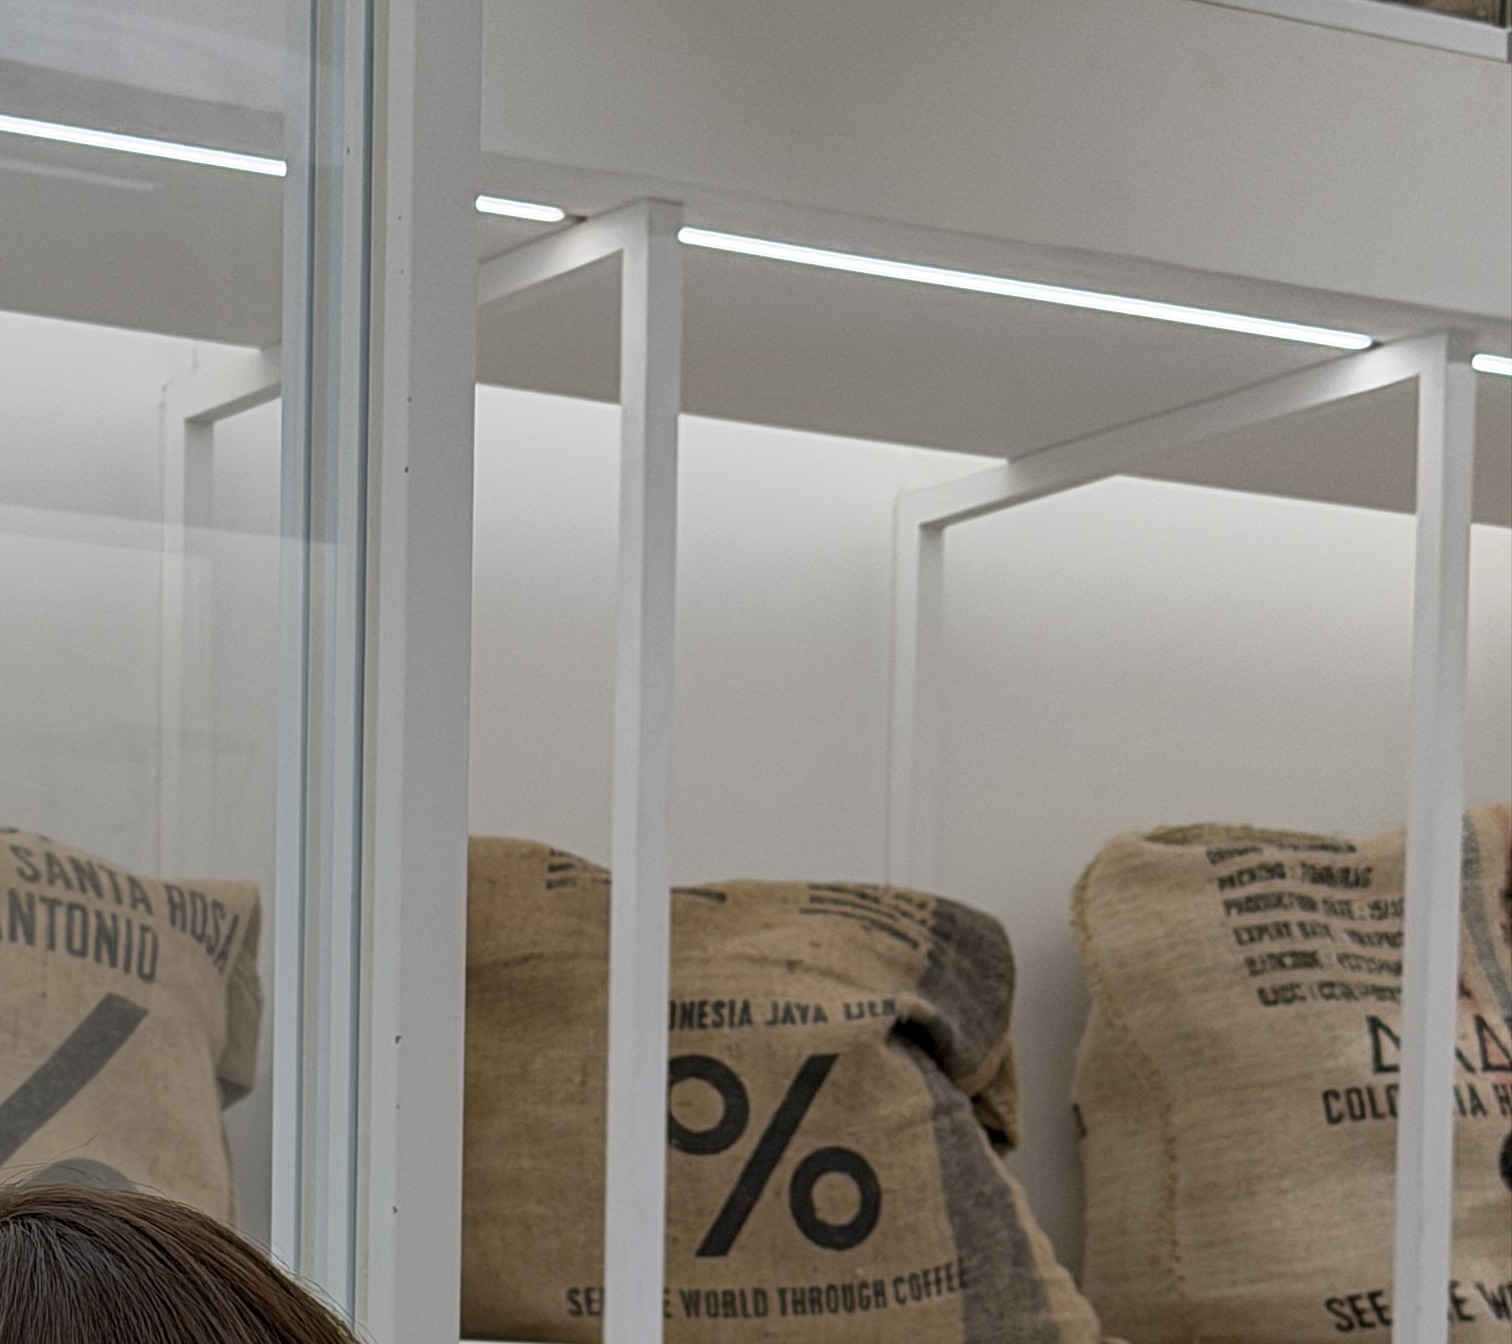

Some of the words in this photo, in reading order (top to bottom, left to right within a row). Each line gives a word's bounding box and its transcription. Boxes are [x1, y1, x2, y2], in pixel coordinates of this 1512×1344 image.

[6, 844, 155, 917] SANTA
[678, 1285, 769, 1319] WORLD
[775, 1275, 887, 1317] THROUGH
